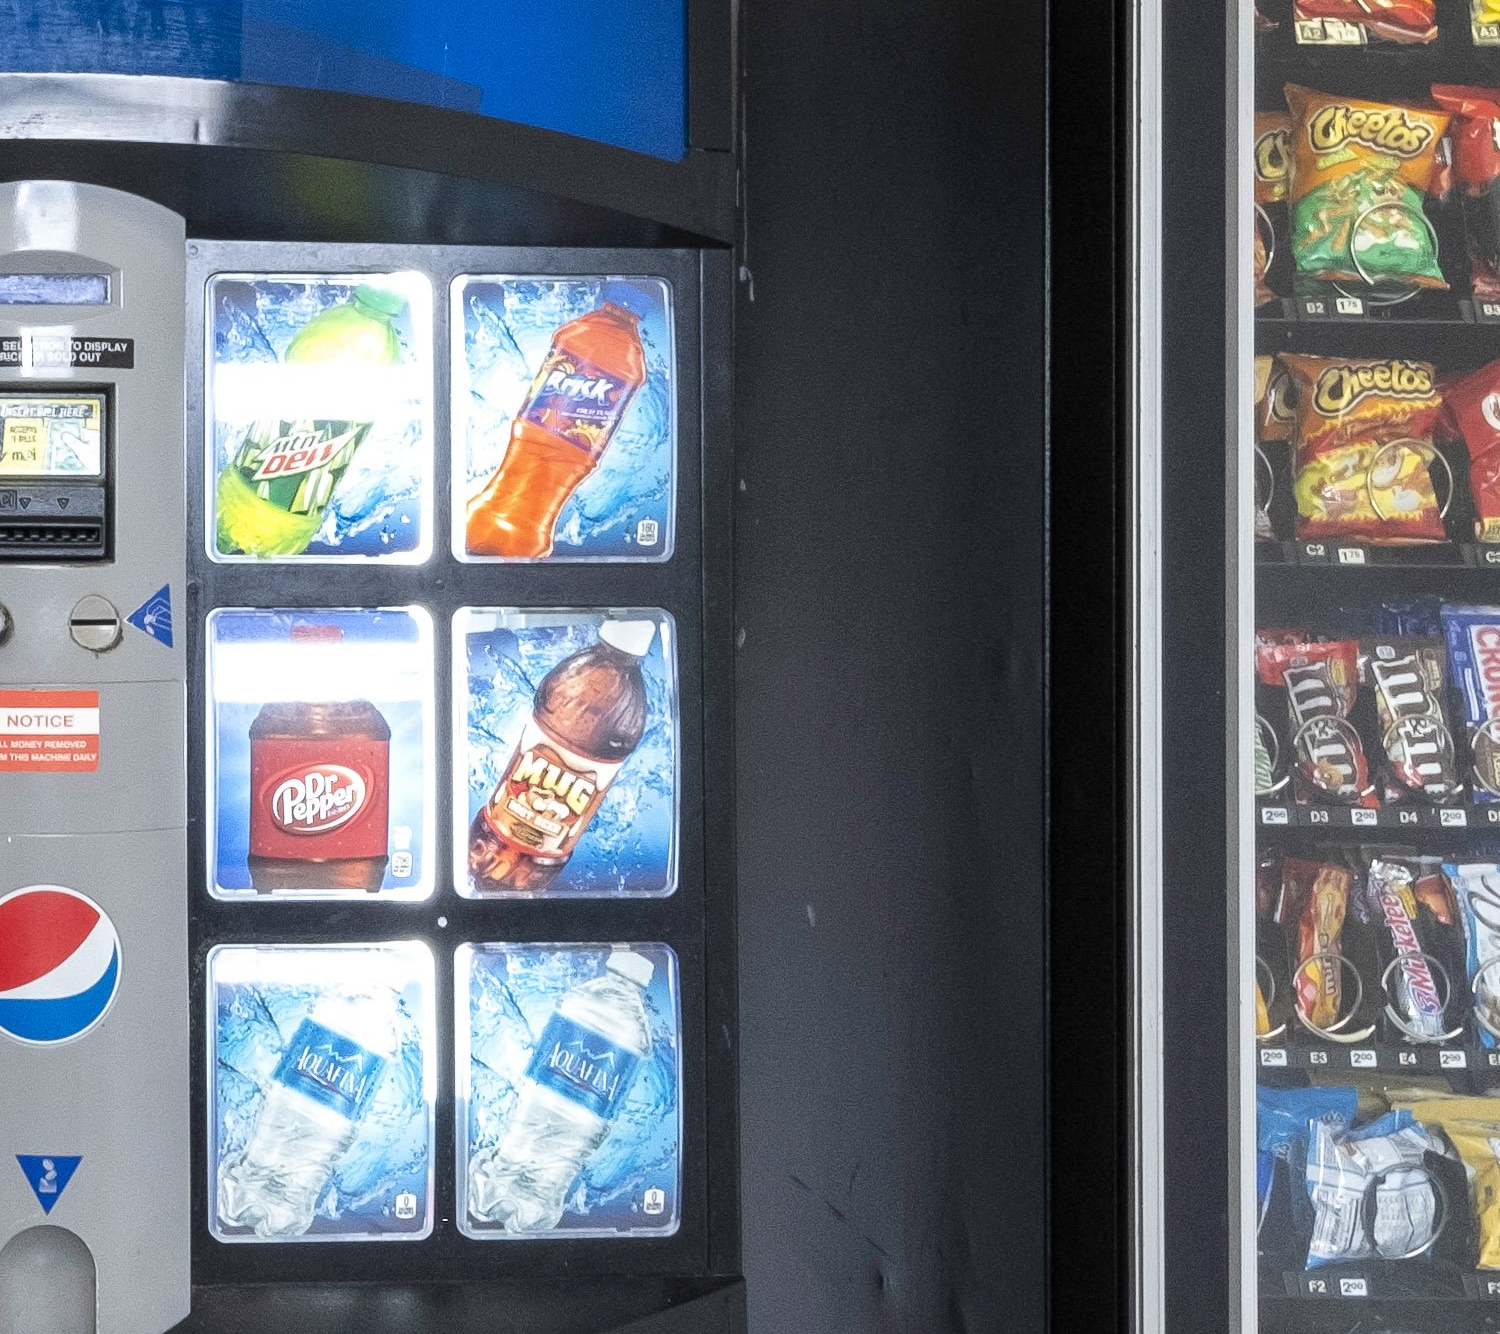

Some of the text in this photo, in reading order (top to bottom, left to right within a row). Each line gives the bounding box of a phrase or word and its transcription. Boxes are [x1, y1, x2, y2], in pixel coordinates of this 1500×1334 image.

[1310, 105, 1432, 155] Cheetos
[79, 352, 102, 363] OUT
[83, 341, 128, 353] DISPLAY
[1313, 363, 1432, 416] Cheetos
[60, 406, 86, 418] HERE
[6, 714, 74, 728] NOTICE
[9, 752, 29, 762] THIS
[30, 752, 72, 762] MACHINE
[72, 753, 98, 762] DAILY
[10, 740, 43, 749] MONEY
[44, 740, 87, 749] REMOVED
[306, 772, 339, 800] Dr
[511, 750, 597, 816] MUG
[282, 780, 359, 826] Pepper
[297, 1047, 366, 1102] AQUAFINA
[549, 1046, 619, 1101] AQUAFINA
